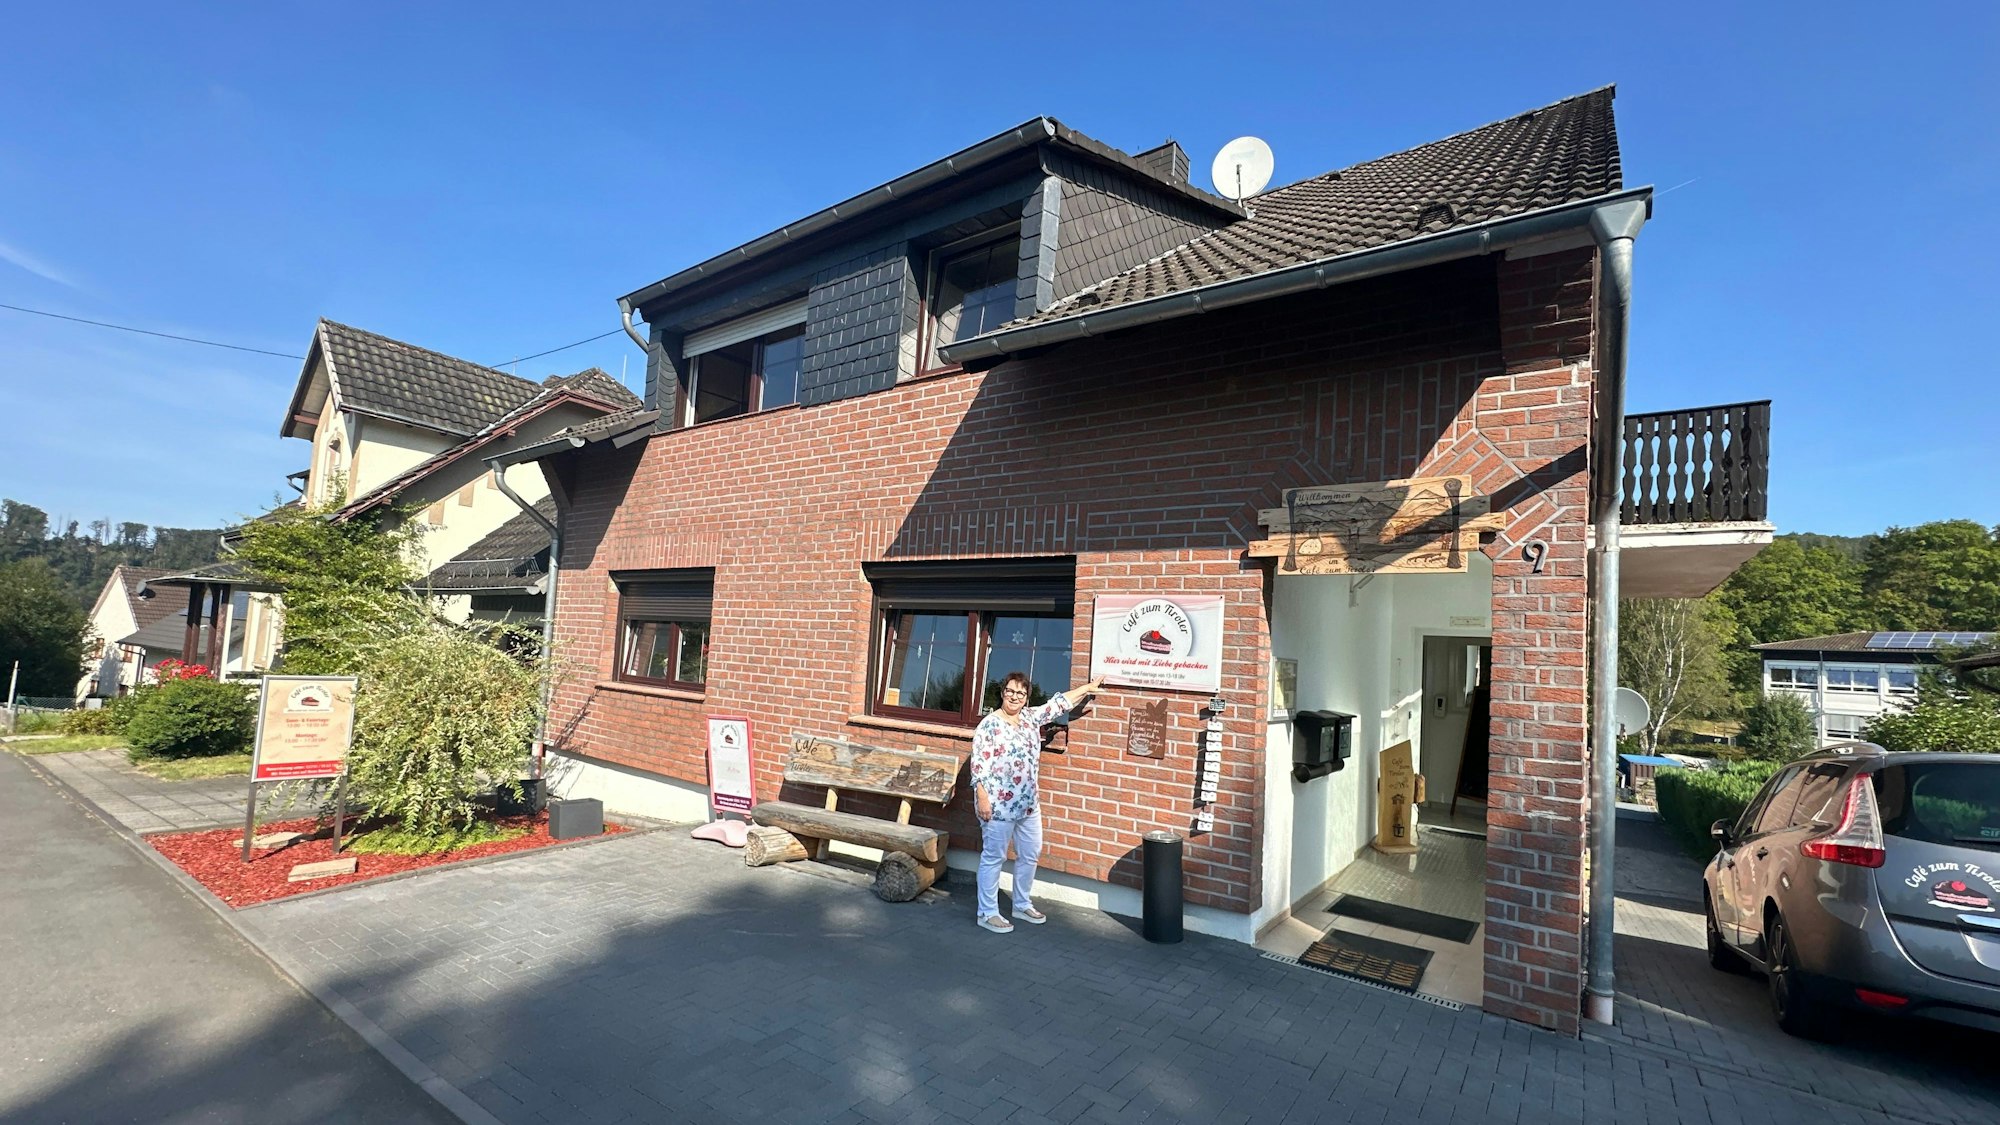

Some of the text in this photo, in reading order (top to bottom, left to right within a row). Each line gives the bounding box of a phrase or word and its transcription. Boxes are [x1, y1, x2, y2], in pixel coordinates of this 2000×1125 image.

[1298, 493, 1351, 502] Willkommen
[1524, 540, 1549, 574] 9
[1122, 604, 1188, 635] Café zum Tiroler
[1104, 656, 1120, 664] Hier
[1152, 659, 1172, 667] Liebe
[1174, 660, 1208, 670] gebacken
[796, 737, 817, 755] Café
[1905, 865, 1928, 887] Café
[1928, 862, 1959, 872] zum
